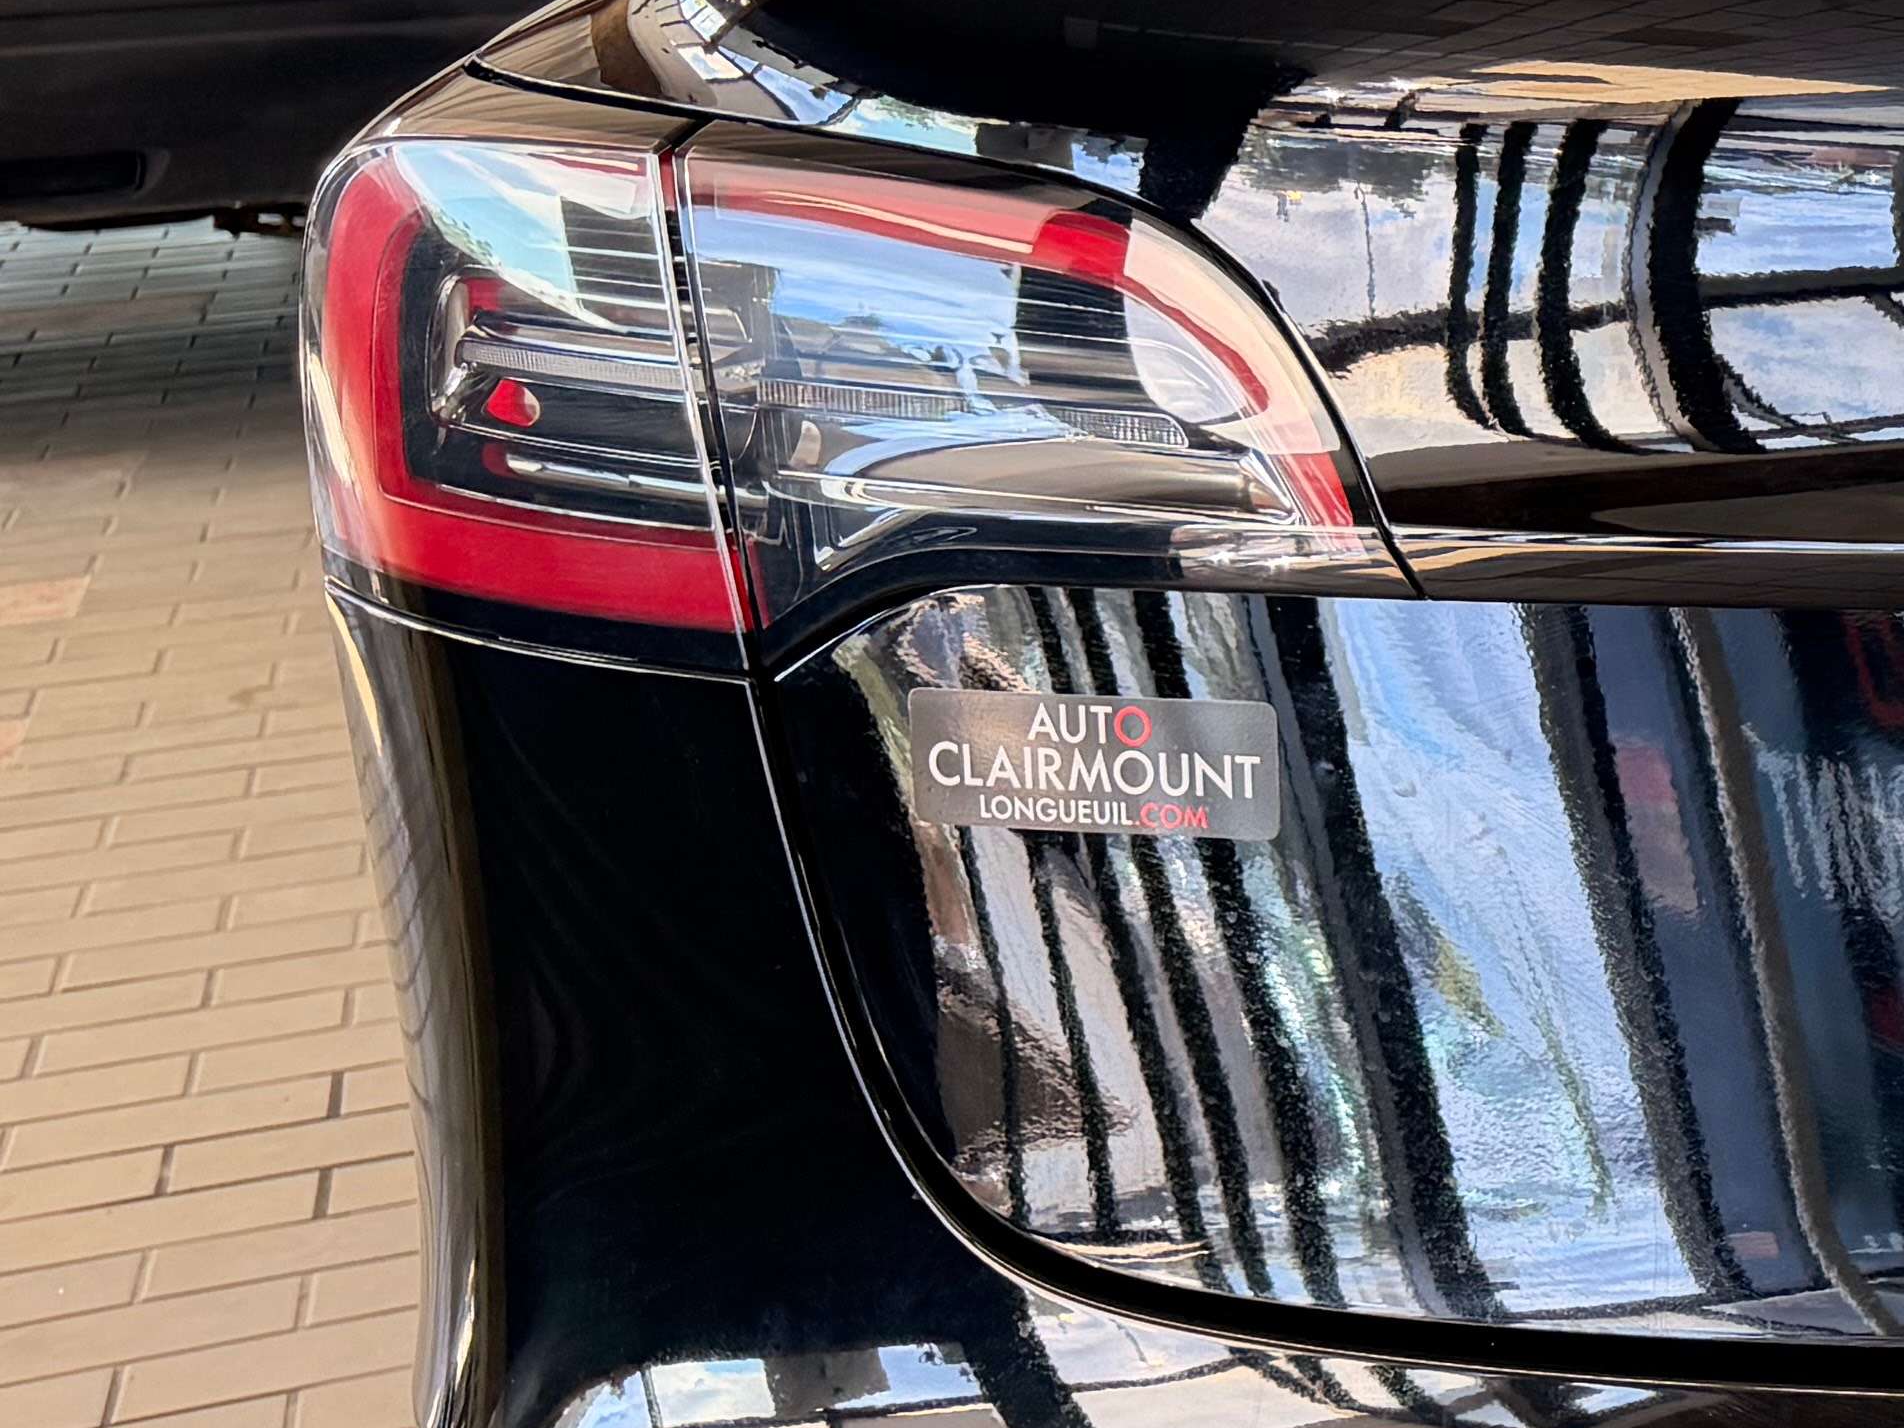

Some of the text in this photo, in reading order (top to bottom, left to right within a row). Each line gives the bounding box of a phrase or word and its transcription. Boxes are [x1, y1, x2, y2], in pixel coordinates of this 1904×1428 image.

[1027, 702, 1153, 748] AUTO
[927, 740, 1262, 801] CLAIRMOUNT
[978, 794, 1209, 830] LONGUEUIL.COM
